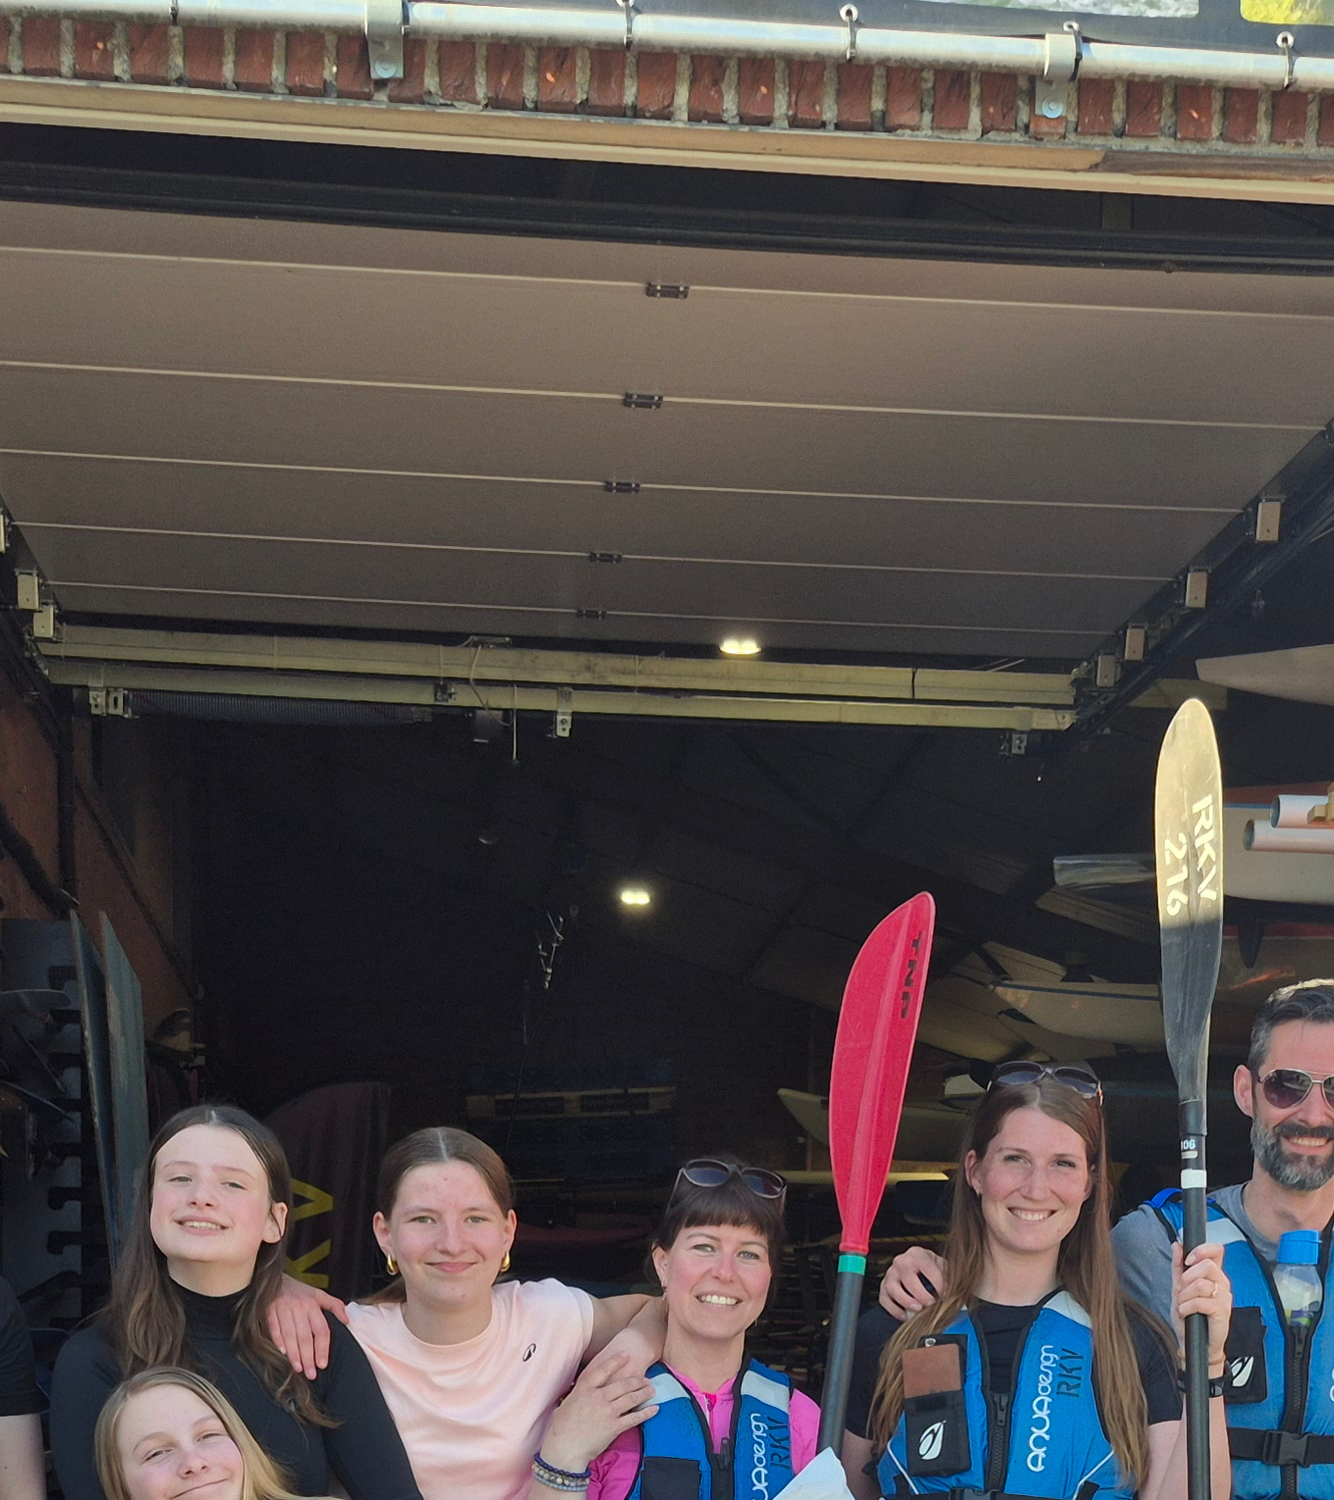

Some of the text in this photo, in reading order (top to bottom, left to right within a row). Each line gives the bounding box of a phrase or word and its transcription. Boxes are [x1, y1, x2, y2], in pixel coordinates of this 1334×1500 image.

[1165, 832, 1189, 917] 216
[1192, 794, 1217, 901] RKV
[1056, 1347, 1084, 1399] RKV
[770, 1416, 790, 1470] RKV
